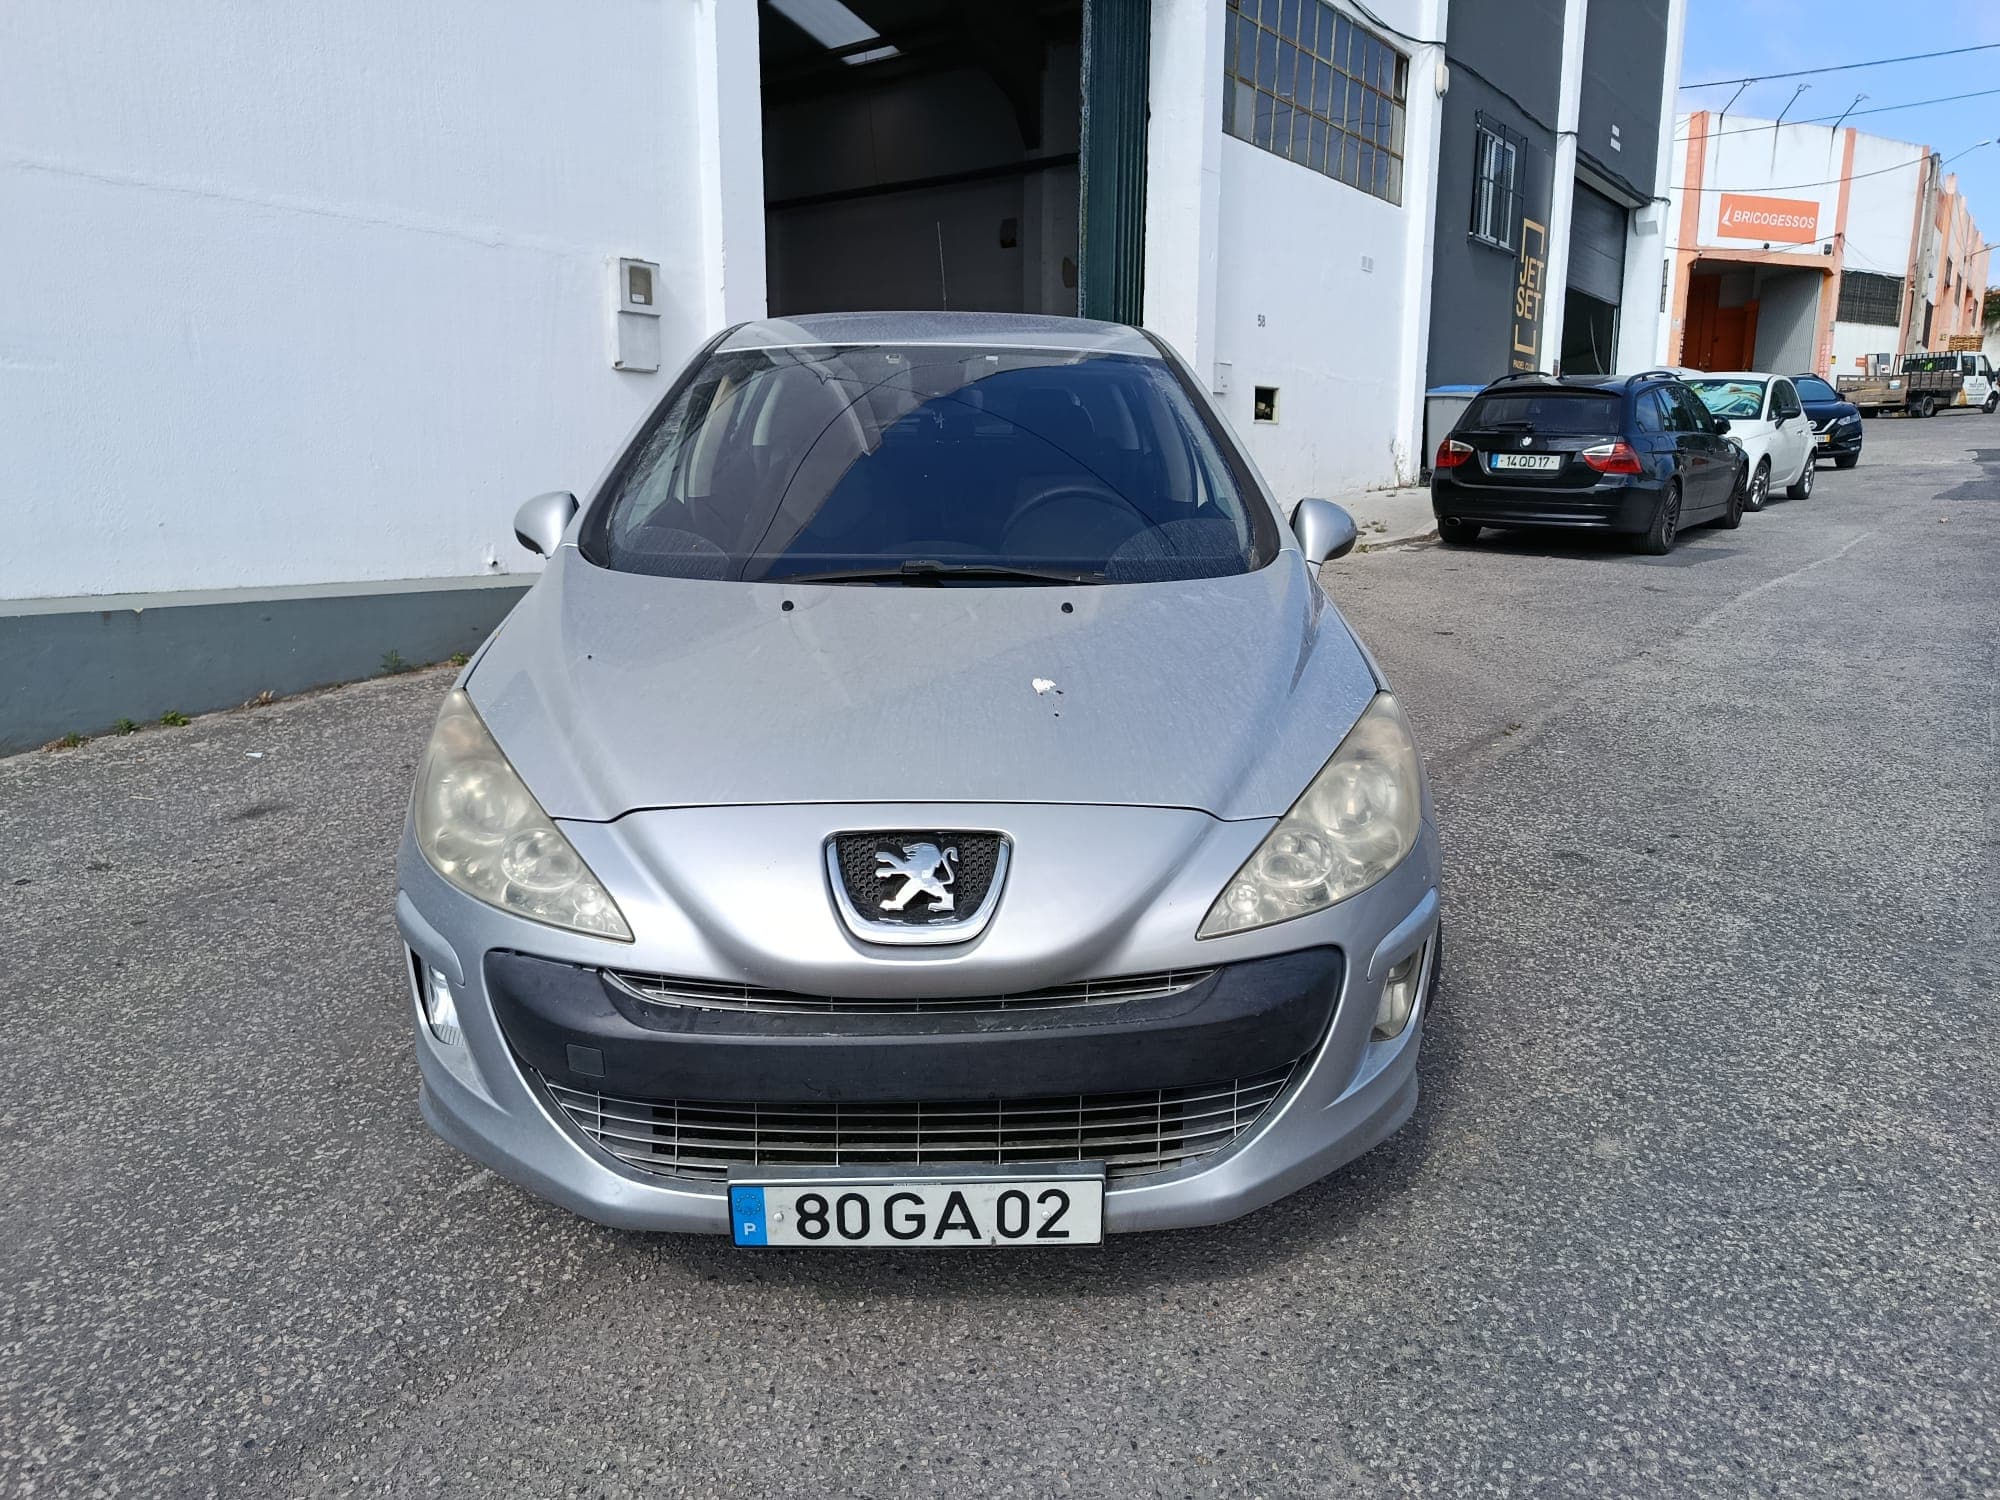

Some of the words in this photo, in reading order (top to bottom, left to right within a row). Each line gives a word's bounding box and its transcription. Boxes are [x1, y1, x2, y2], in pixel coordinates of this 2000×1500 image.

[1733, 210, 1815, 229] BRICOGESSOS
[1519, 255, 1544, 291] JET
[1516, 286, 1542, 322] SET
[744, 1223, 756, 1236] P
[795, 1192, 870, 1240] 80
[884, 1190, 981, 1240] GA
[996, 1188, 1070, 1238] 02
